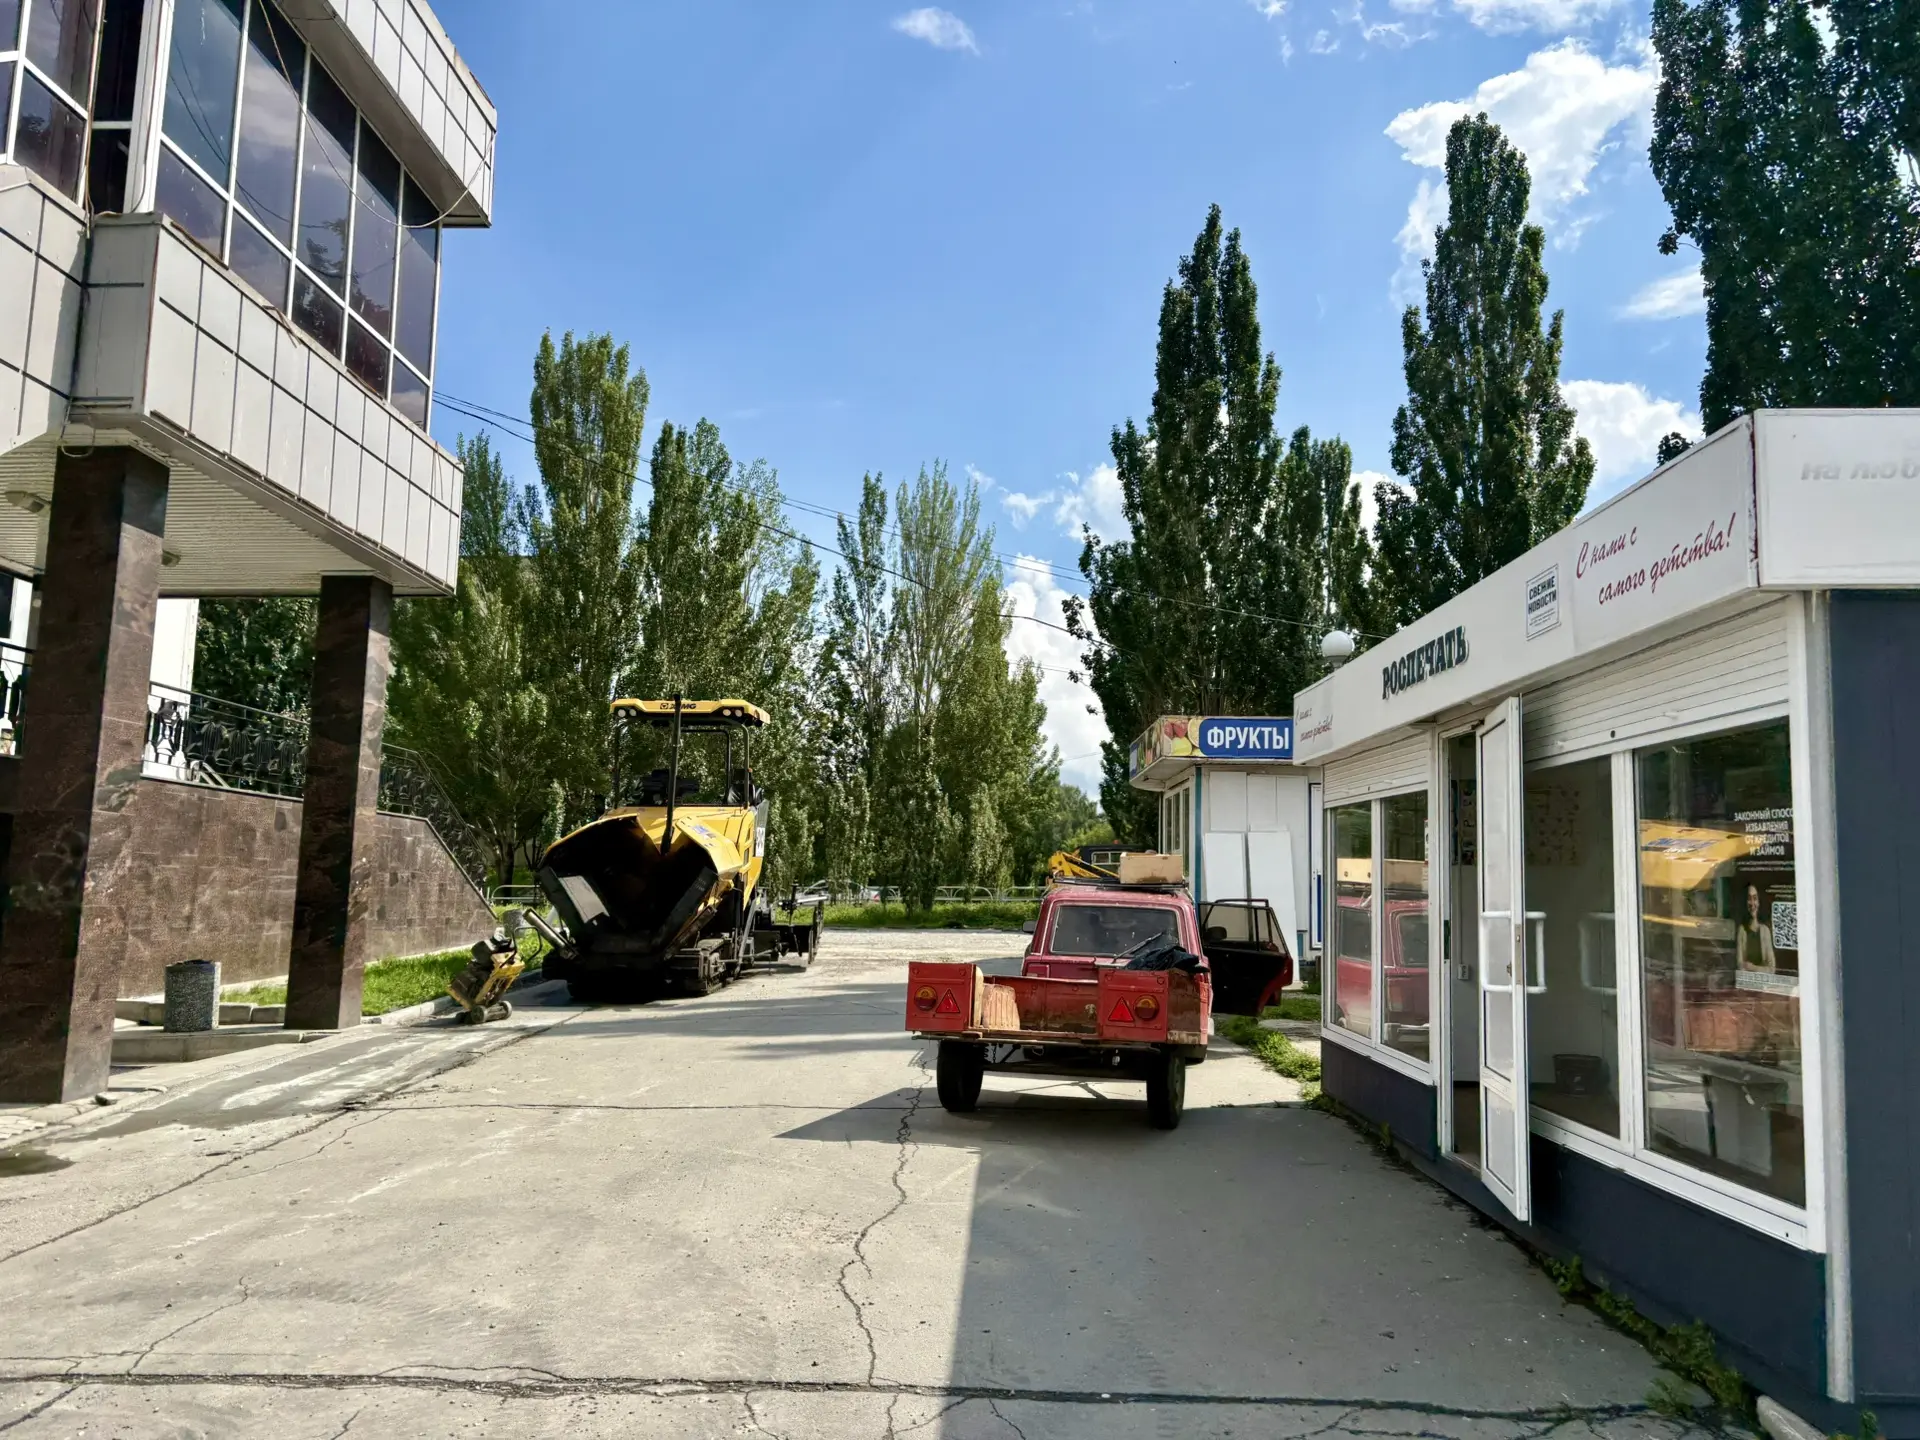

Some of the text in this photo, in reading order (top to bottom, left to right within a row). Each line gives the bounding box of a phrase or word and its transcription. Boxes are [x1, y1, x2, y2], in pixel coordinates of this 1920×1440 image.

[1590, 531, 1626, 568] нами
[1598, 511, 1737, 605] самого детства!
[1527, 589, 1557, 614] НОВОСТИ
[1382, 624, 1469, 701] РОСПЕЧАТЬ
[1207, 726, 1290, 750] ФРУКТЫ
[1734, 808, 1794, 821] ЗАКОННЫЙ СПОСО
[1745, 821, 1789, 832] ИЗБАВЛЕНИЯ
[1754, 832, 1790, 844] КРЕДИТОВ
[1757, 844, 1785, 856] ЗАЙМОВ
